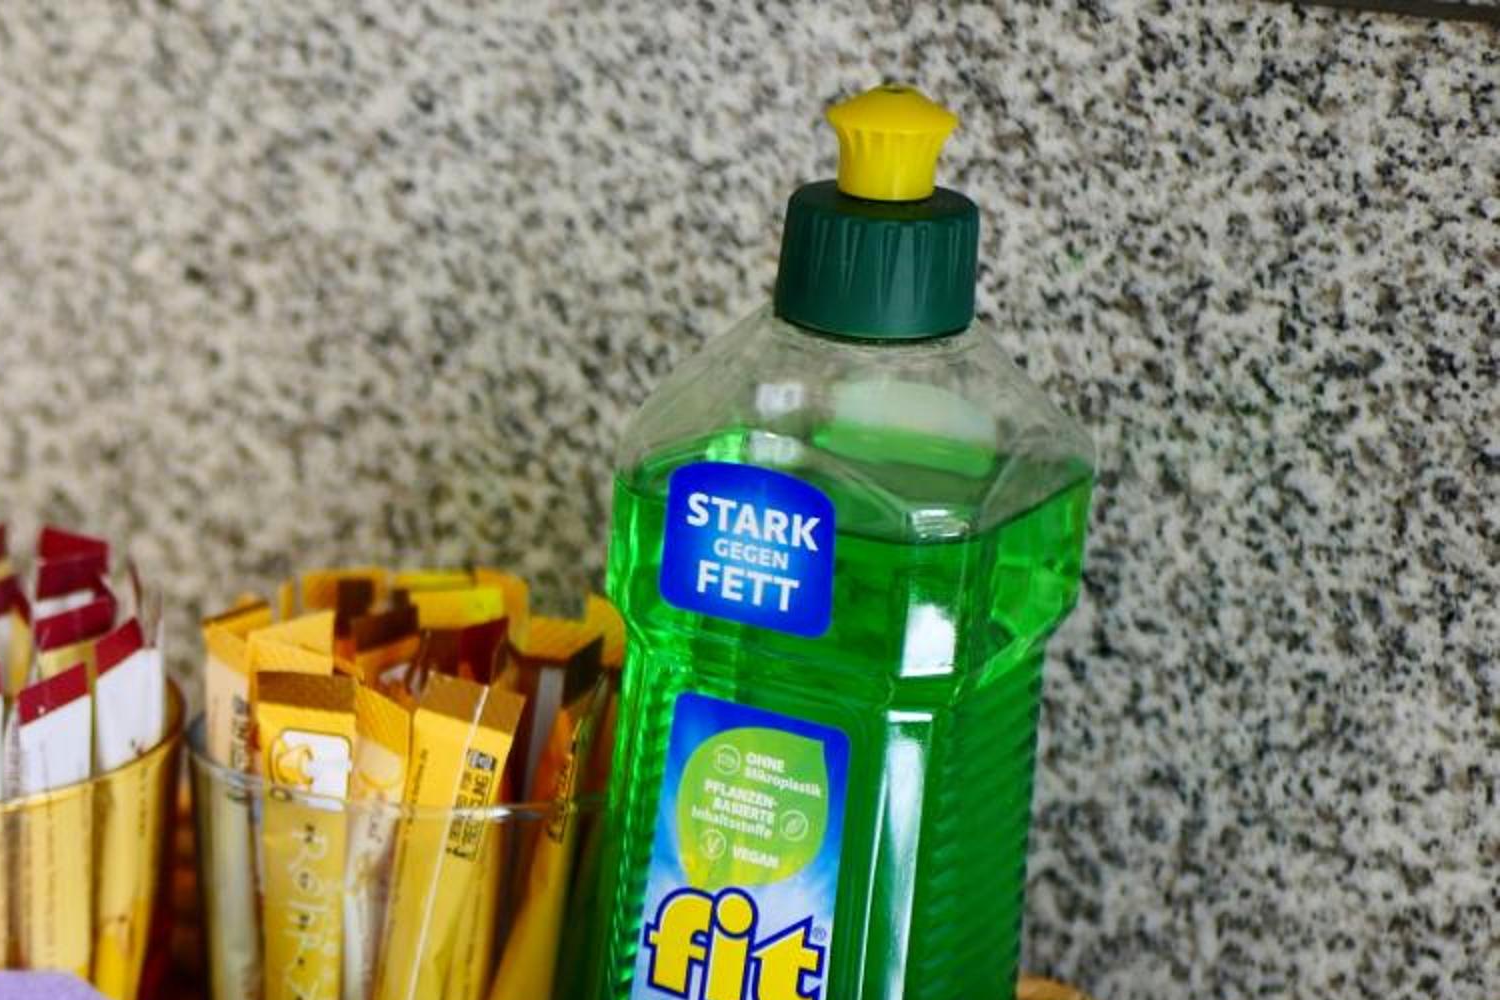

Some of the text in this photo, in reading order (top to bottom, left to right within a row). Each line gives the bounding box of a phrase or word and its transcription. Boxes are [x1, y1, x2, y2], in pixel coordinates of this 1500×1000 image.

[686, 491, 821, 551] STARK
[713, 538, 789, 570] GEGEN
[696, 559, 800, 612] FETT
[745, 752, 785, 772] OHNE
[744, 767, 822, 798] Mikroplastik
[733, 845, 780, 869] VEGAN
